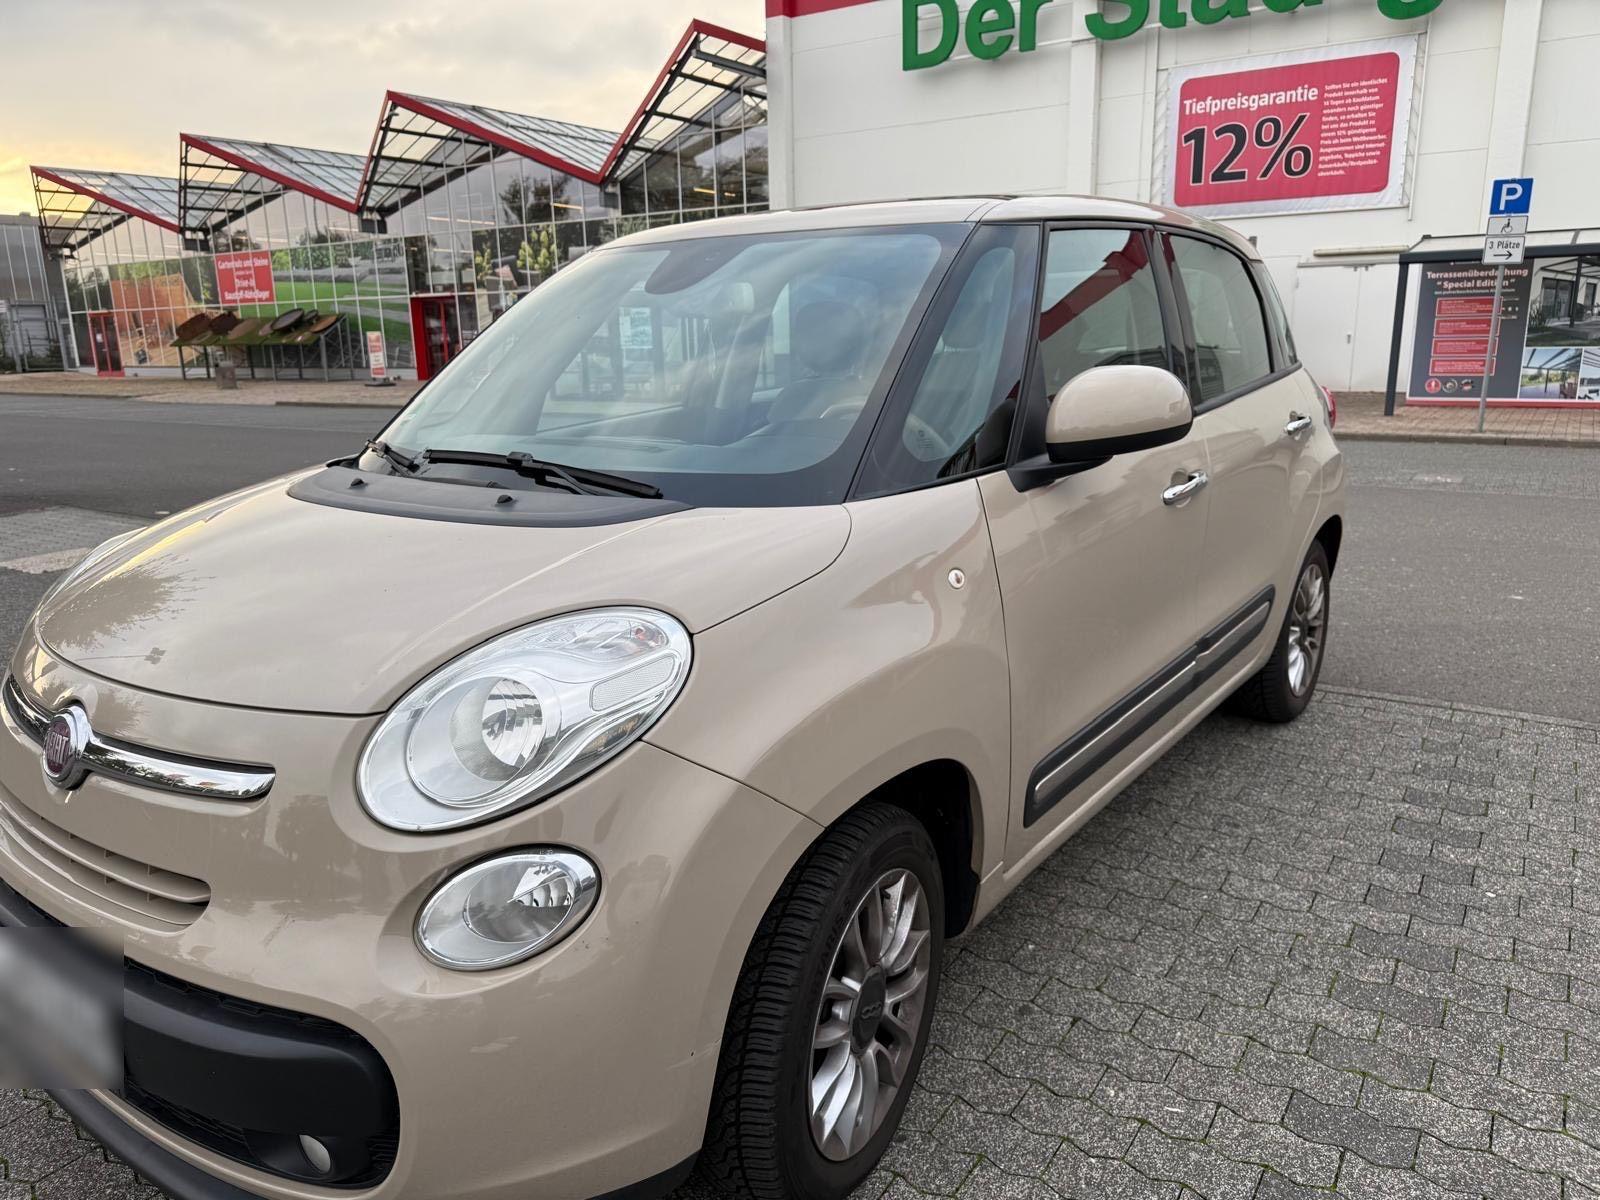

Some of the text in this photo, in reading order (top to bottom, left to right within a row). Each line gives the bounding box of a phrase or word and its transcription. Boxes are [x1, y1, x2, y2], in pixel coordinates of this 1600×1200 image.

[902, 0, 1052, 72] Der
[1183, 84, 1319, 116] Tiefpreisgarantie
[1182, 112, 1313, 186] 12%
[1499, 183, 1522, 211] P
[1489, 240, 1521, 249] 3 Plätze
[1426, 268, 1529, 280] Terrassenüberdahung
[1442, 280, 1475, 290] Special
